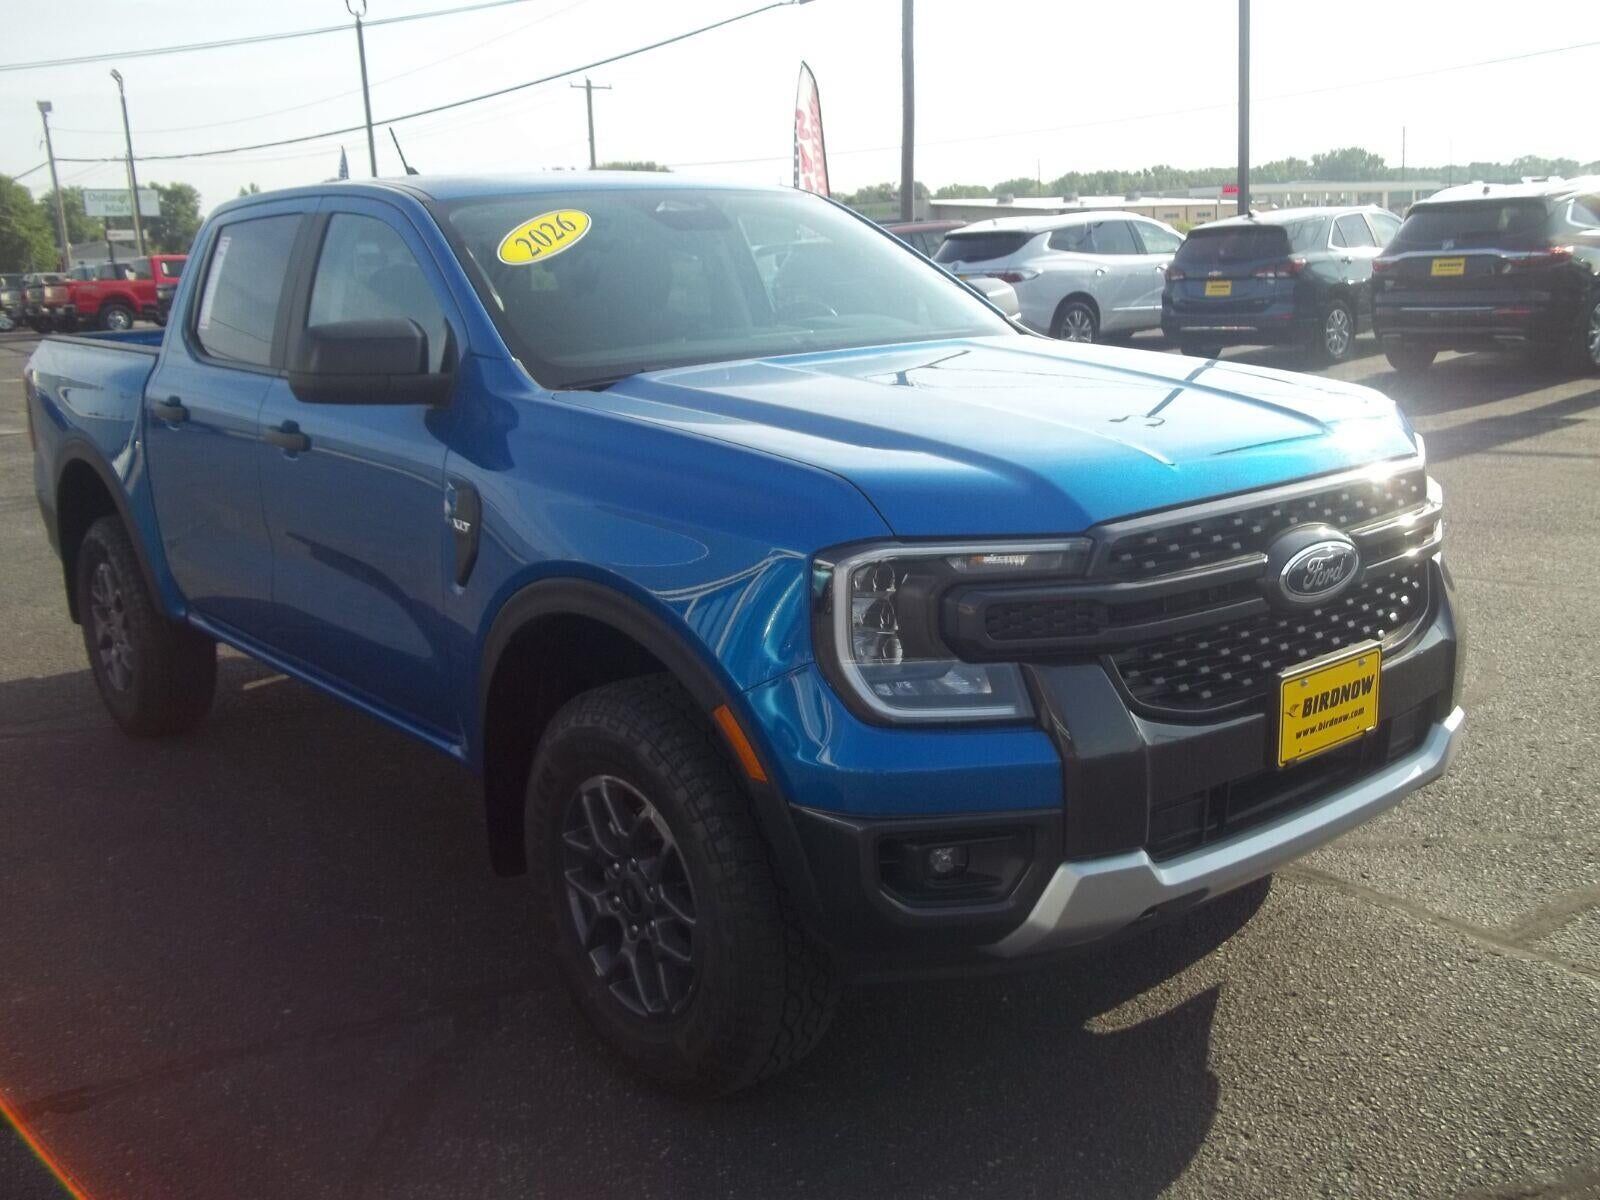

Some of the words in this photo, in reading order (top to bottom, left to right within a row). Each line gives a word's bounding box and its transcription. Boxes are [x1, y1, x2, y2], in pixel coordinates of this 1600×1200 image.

[514, 213, 577, 257] 2026
[1302, 552, 1347, 590] Ford
[1301, 673, 1376, 719] BIRDNOW
[1295, 706, 1365, 740] www.birdnow.com
